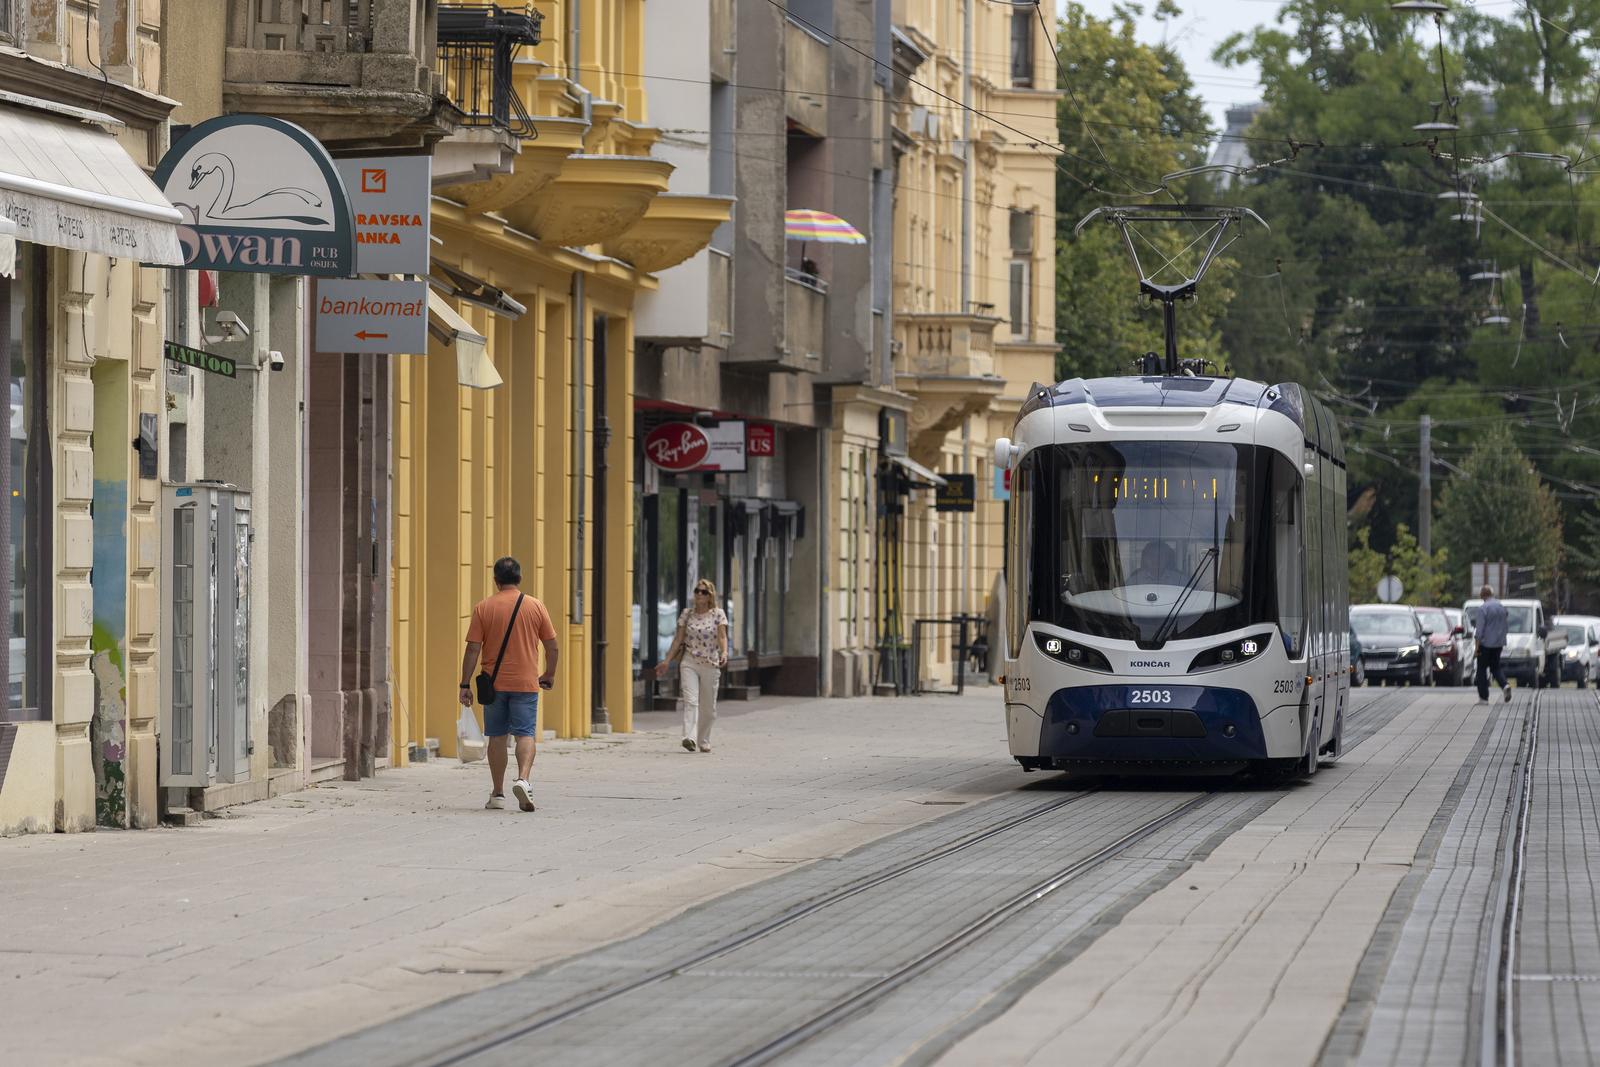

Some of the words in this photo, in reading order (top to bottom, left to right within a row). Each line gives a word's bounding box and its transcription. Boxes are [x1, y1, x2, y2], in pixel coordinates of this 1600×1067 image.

[354, 214, 422, 226] RAVSKA
[357, 232, 400, 244] ANKA
[312, 247, 338, 258] PUB
[310, 260, 338, 269] OSIJEK
[320, 296, 423, 317] bankomat
[168, 344, 234, 375] TATTOO
[648, 430, 705, 462] Ray-Ban
[747, 439, 771, 453] US
[1014, 677, 1031, 691] 2503
[1274, 680, 1294, 694] 2503
[1131, 690, 1171, 703] 2503
